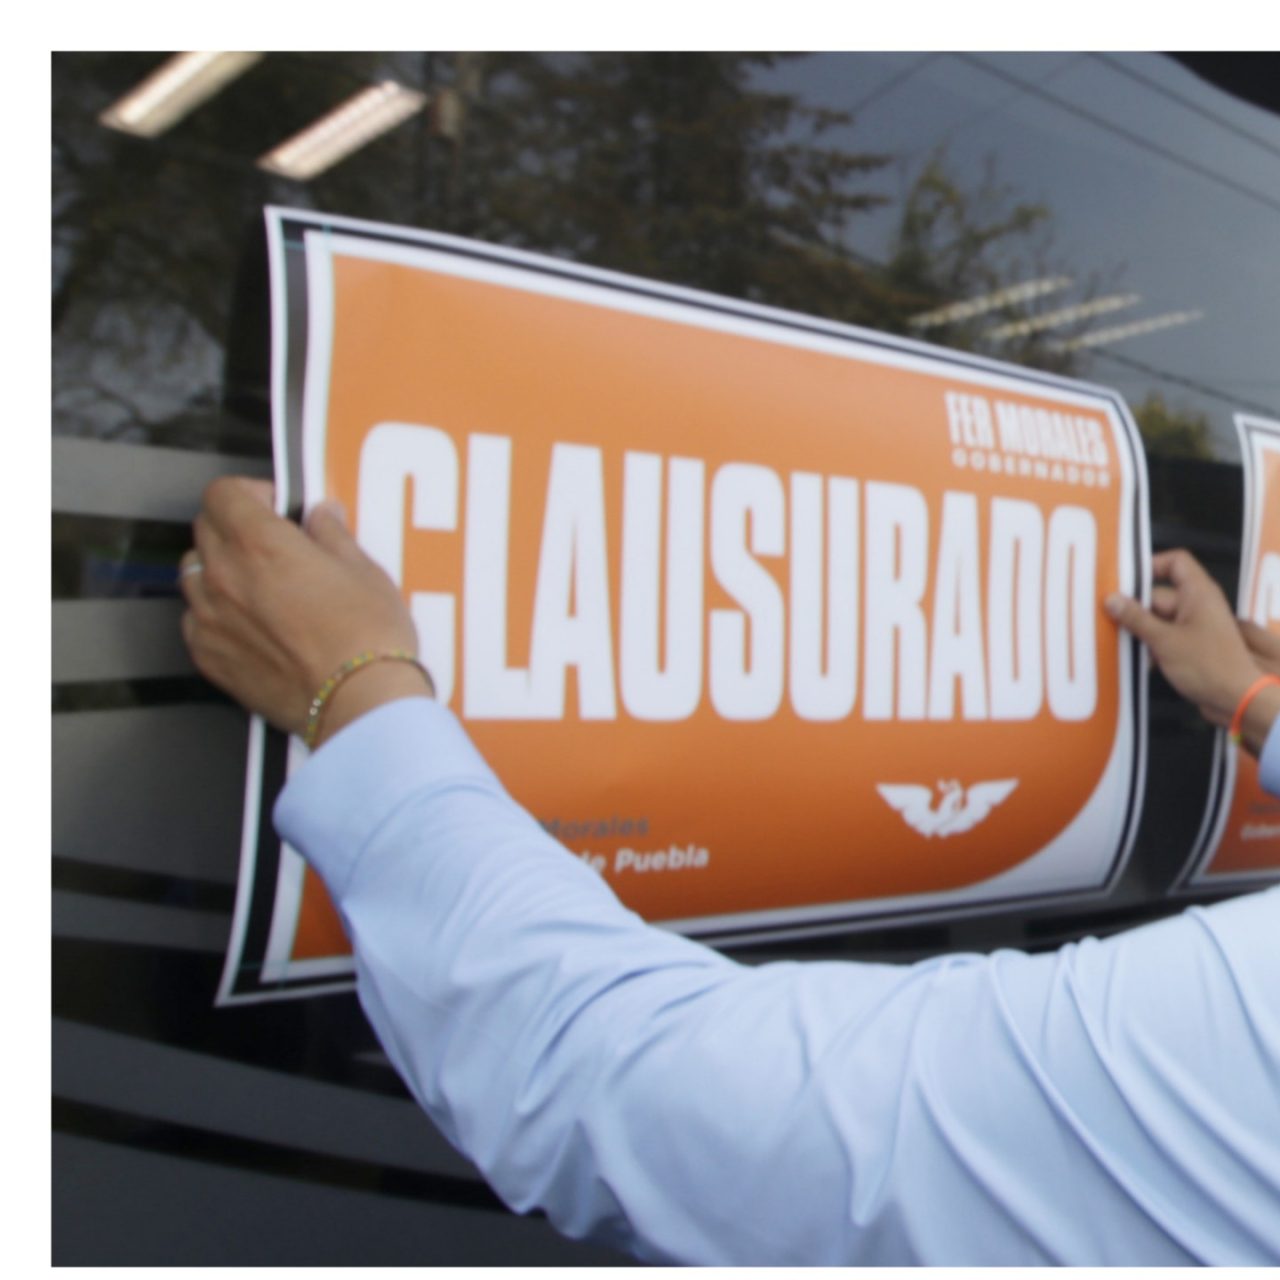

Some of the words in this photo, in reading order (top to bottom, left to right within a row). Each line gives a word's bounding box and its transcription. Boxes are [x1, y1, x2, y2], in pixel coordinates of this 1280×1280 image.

[945, 390, 995, 449] FER
[994, 401, 1110, 466] MORALES
[355, 421, 1098, 721] CLAUSURADO
[614, 844, 710, 873] Puebla
